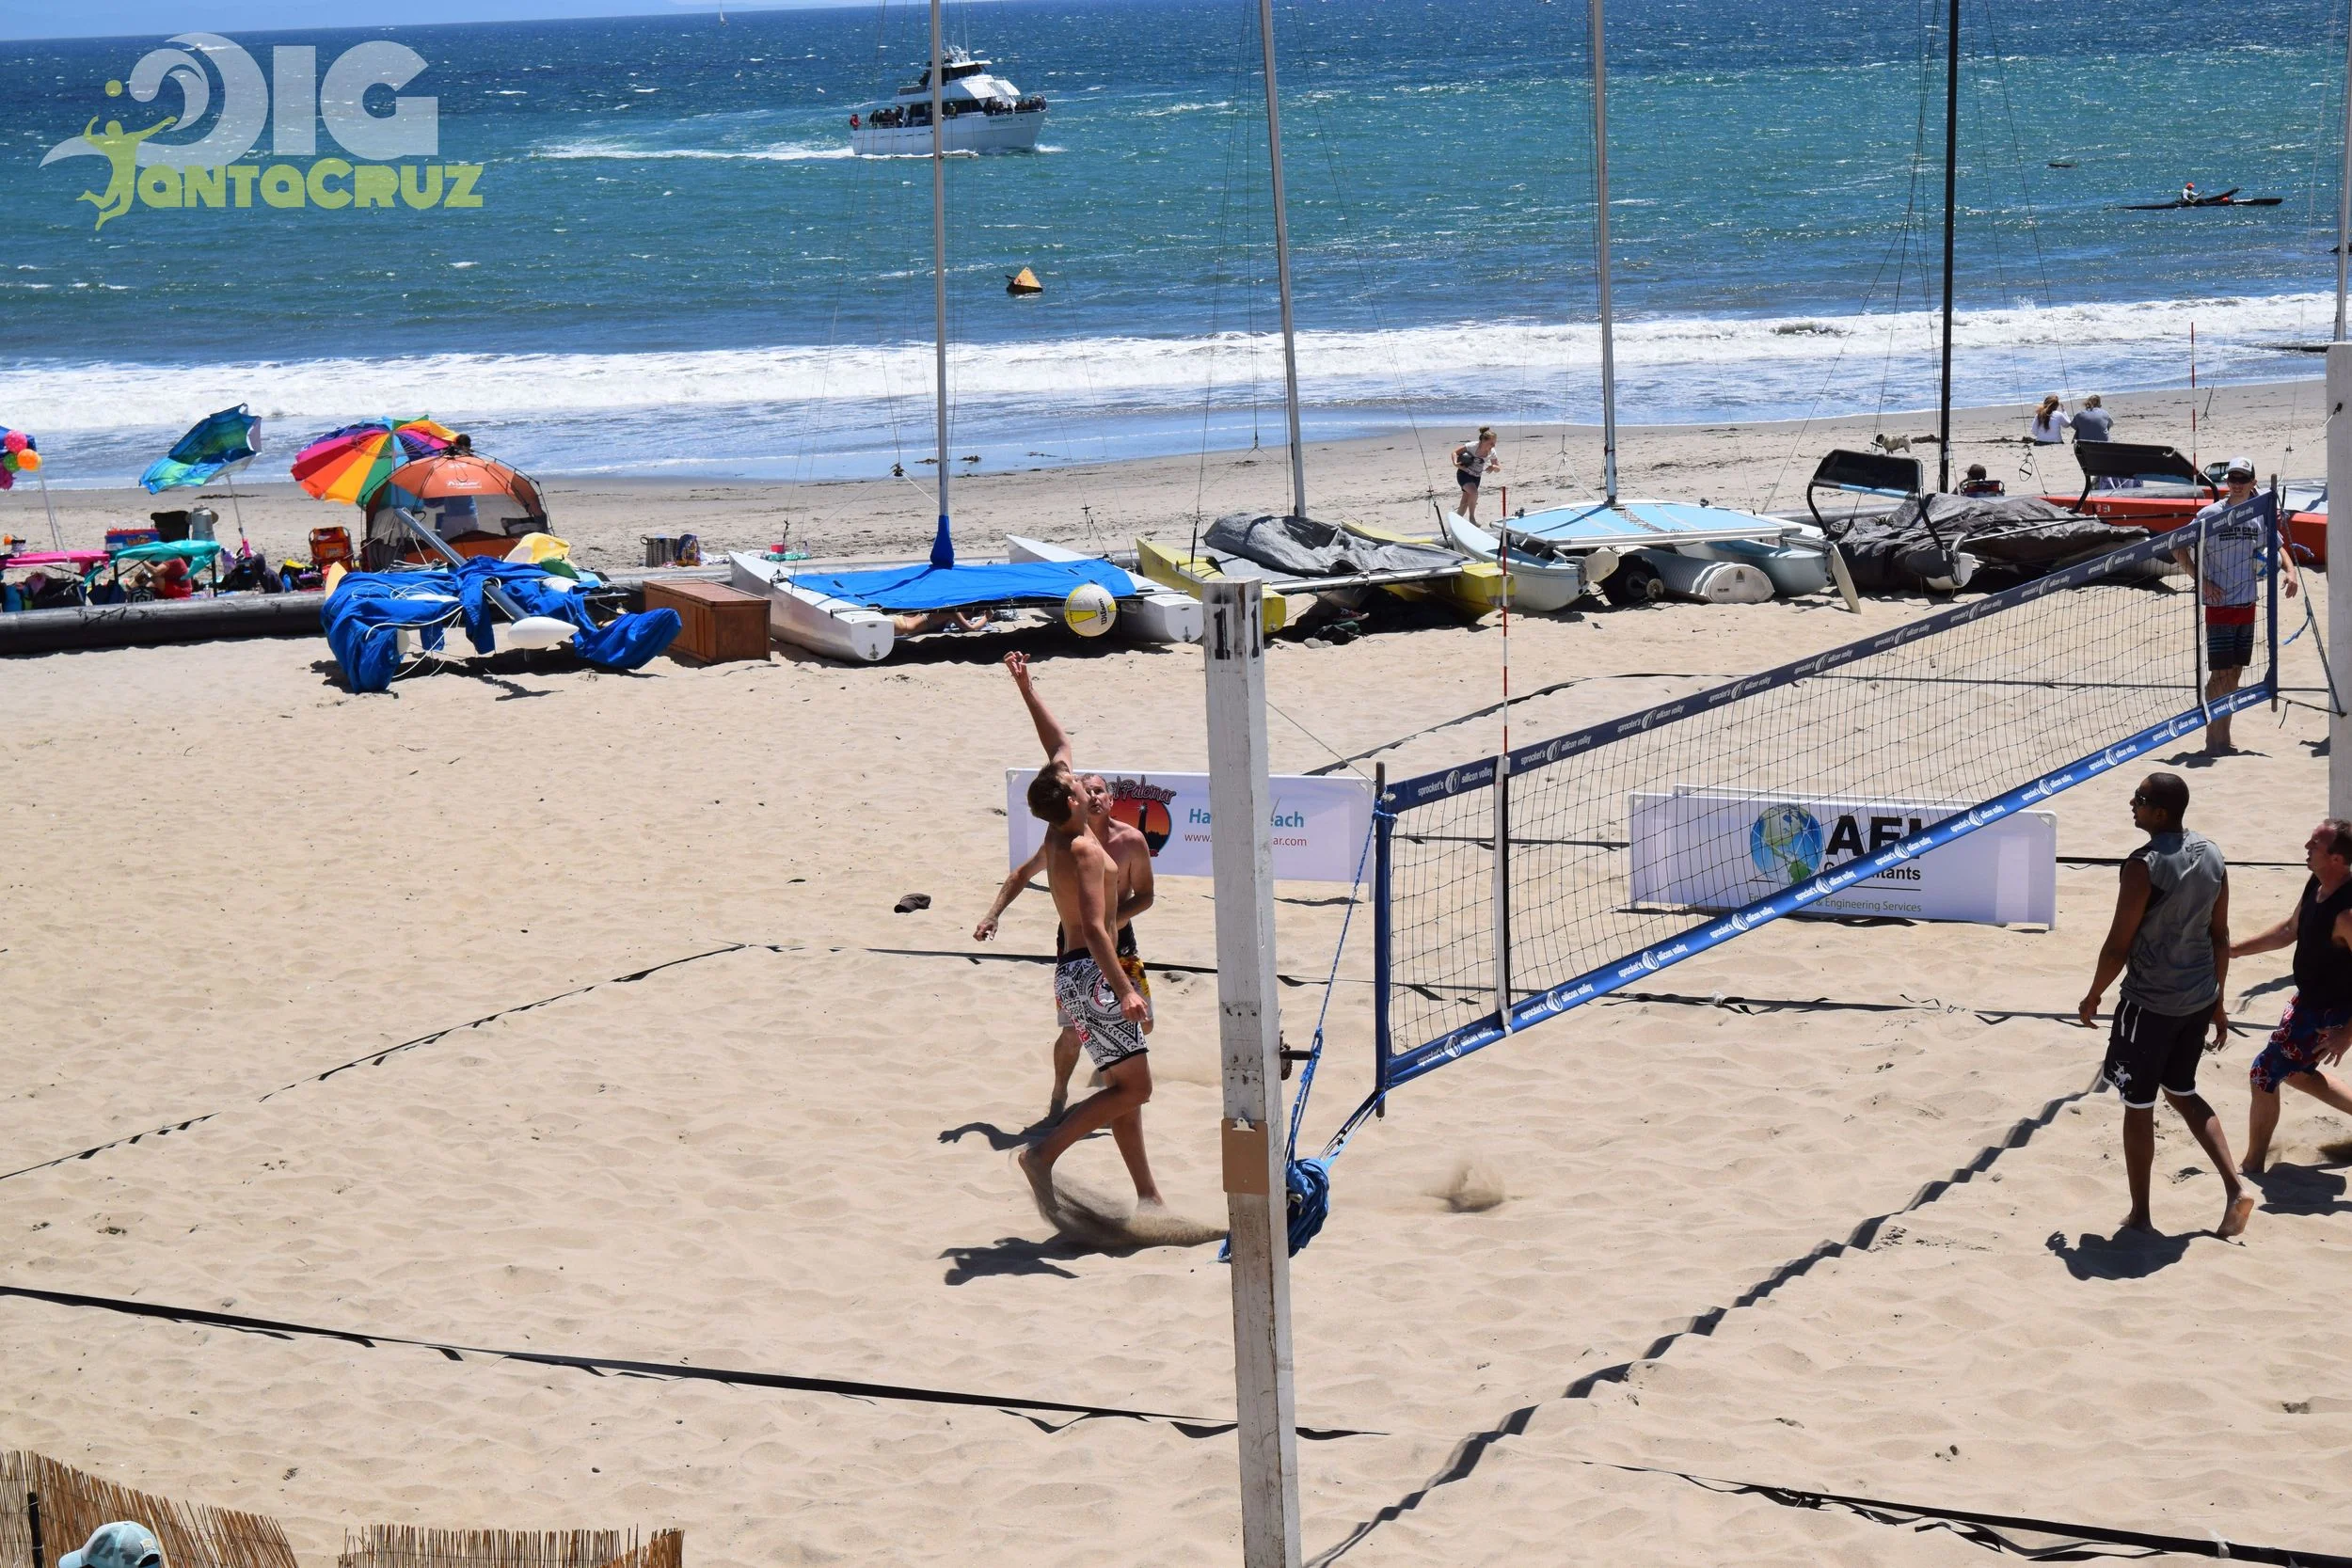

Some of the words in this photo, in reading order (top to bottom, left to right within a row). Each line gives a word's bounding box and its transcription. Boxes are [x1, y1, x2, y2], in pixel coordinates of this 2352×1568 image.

[1098, 597, 1108, 626] Wilson
[1562, 740, 1577, 752] silicon
[1461, 771, 1478, 784] silicon
[1121, 774, 1177, 805] Palomar
[1825, 897, 1881, 911] Engineering
[1883, 900, 1922, 912] Services
[1562, 990, 1580, 1002] silicon
